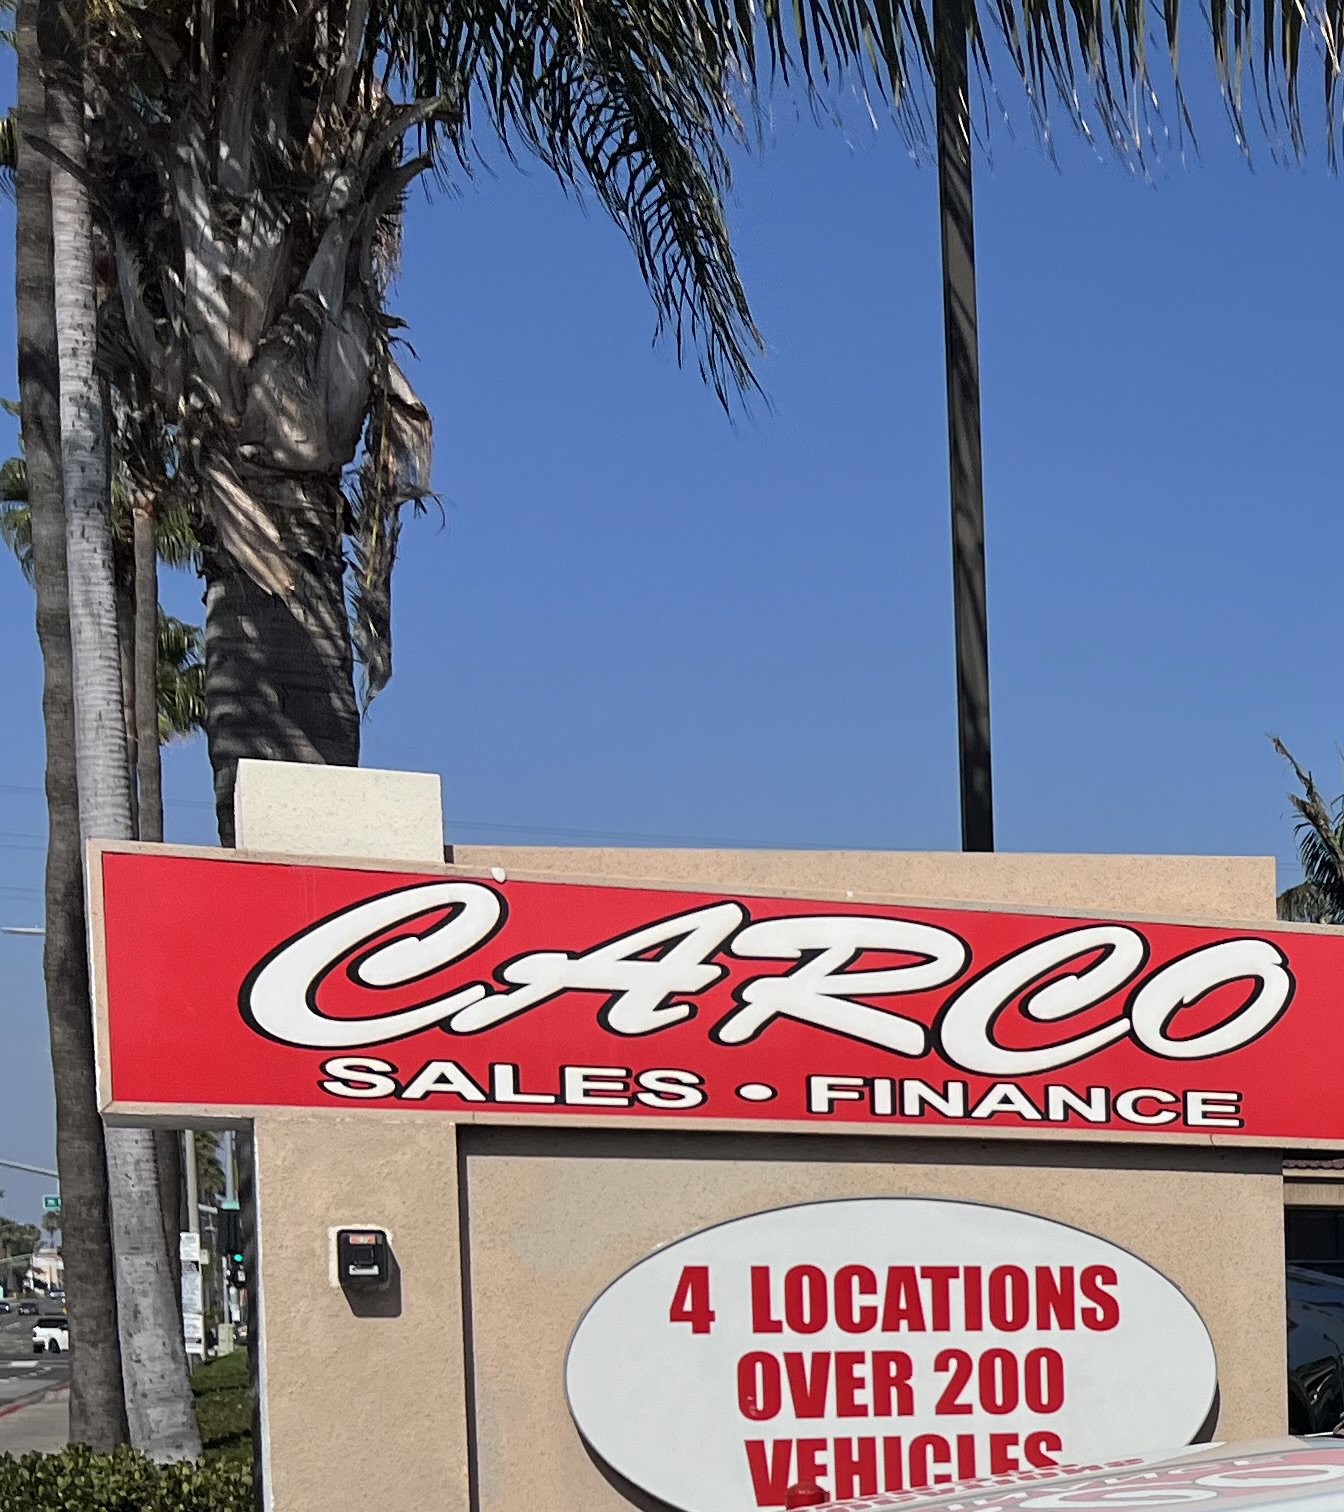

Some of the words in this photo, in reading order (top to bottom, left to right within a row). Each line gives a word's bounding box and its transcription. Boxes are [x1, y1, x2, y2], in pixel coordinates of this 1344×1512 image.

[237, 880, 1297, 1077] CARCO
[319, 1057, 708, 1109] SALES
[806, 1074, 1244, 1129] FINANCE
[669, 1265, 715, 1334] 4
[750, 1264, 1120, 1334] LOCATIONS
[737, 1349, 914, 1421] OVER
[933, 1347, 1065, 1415] 200
